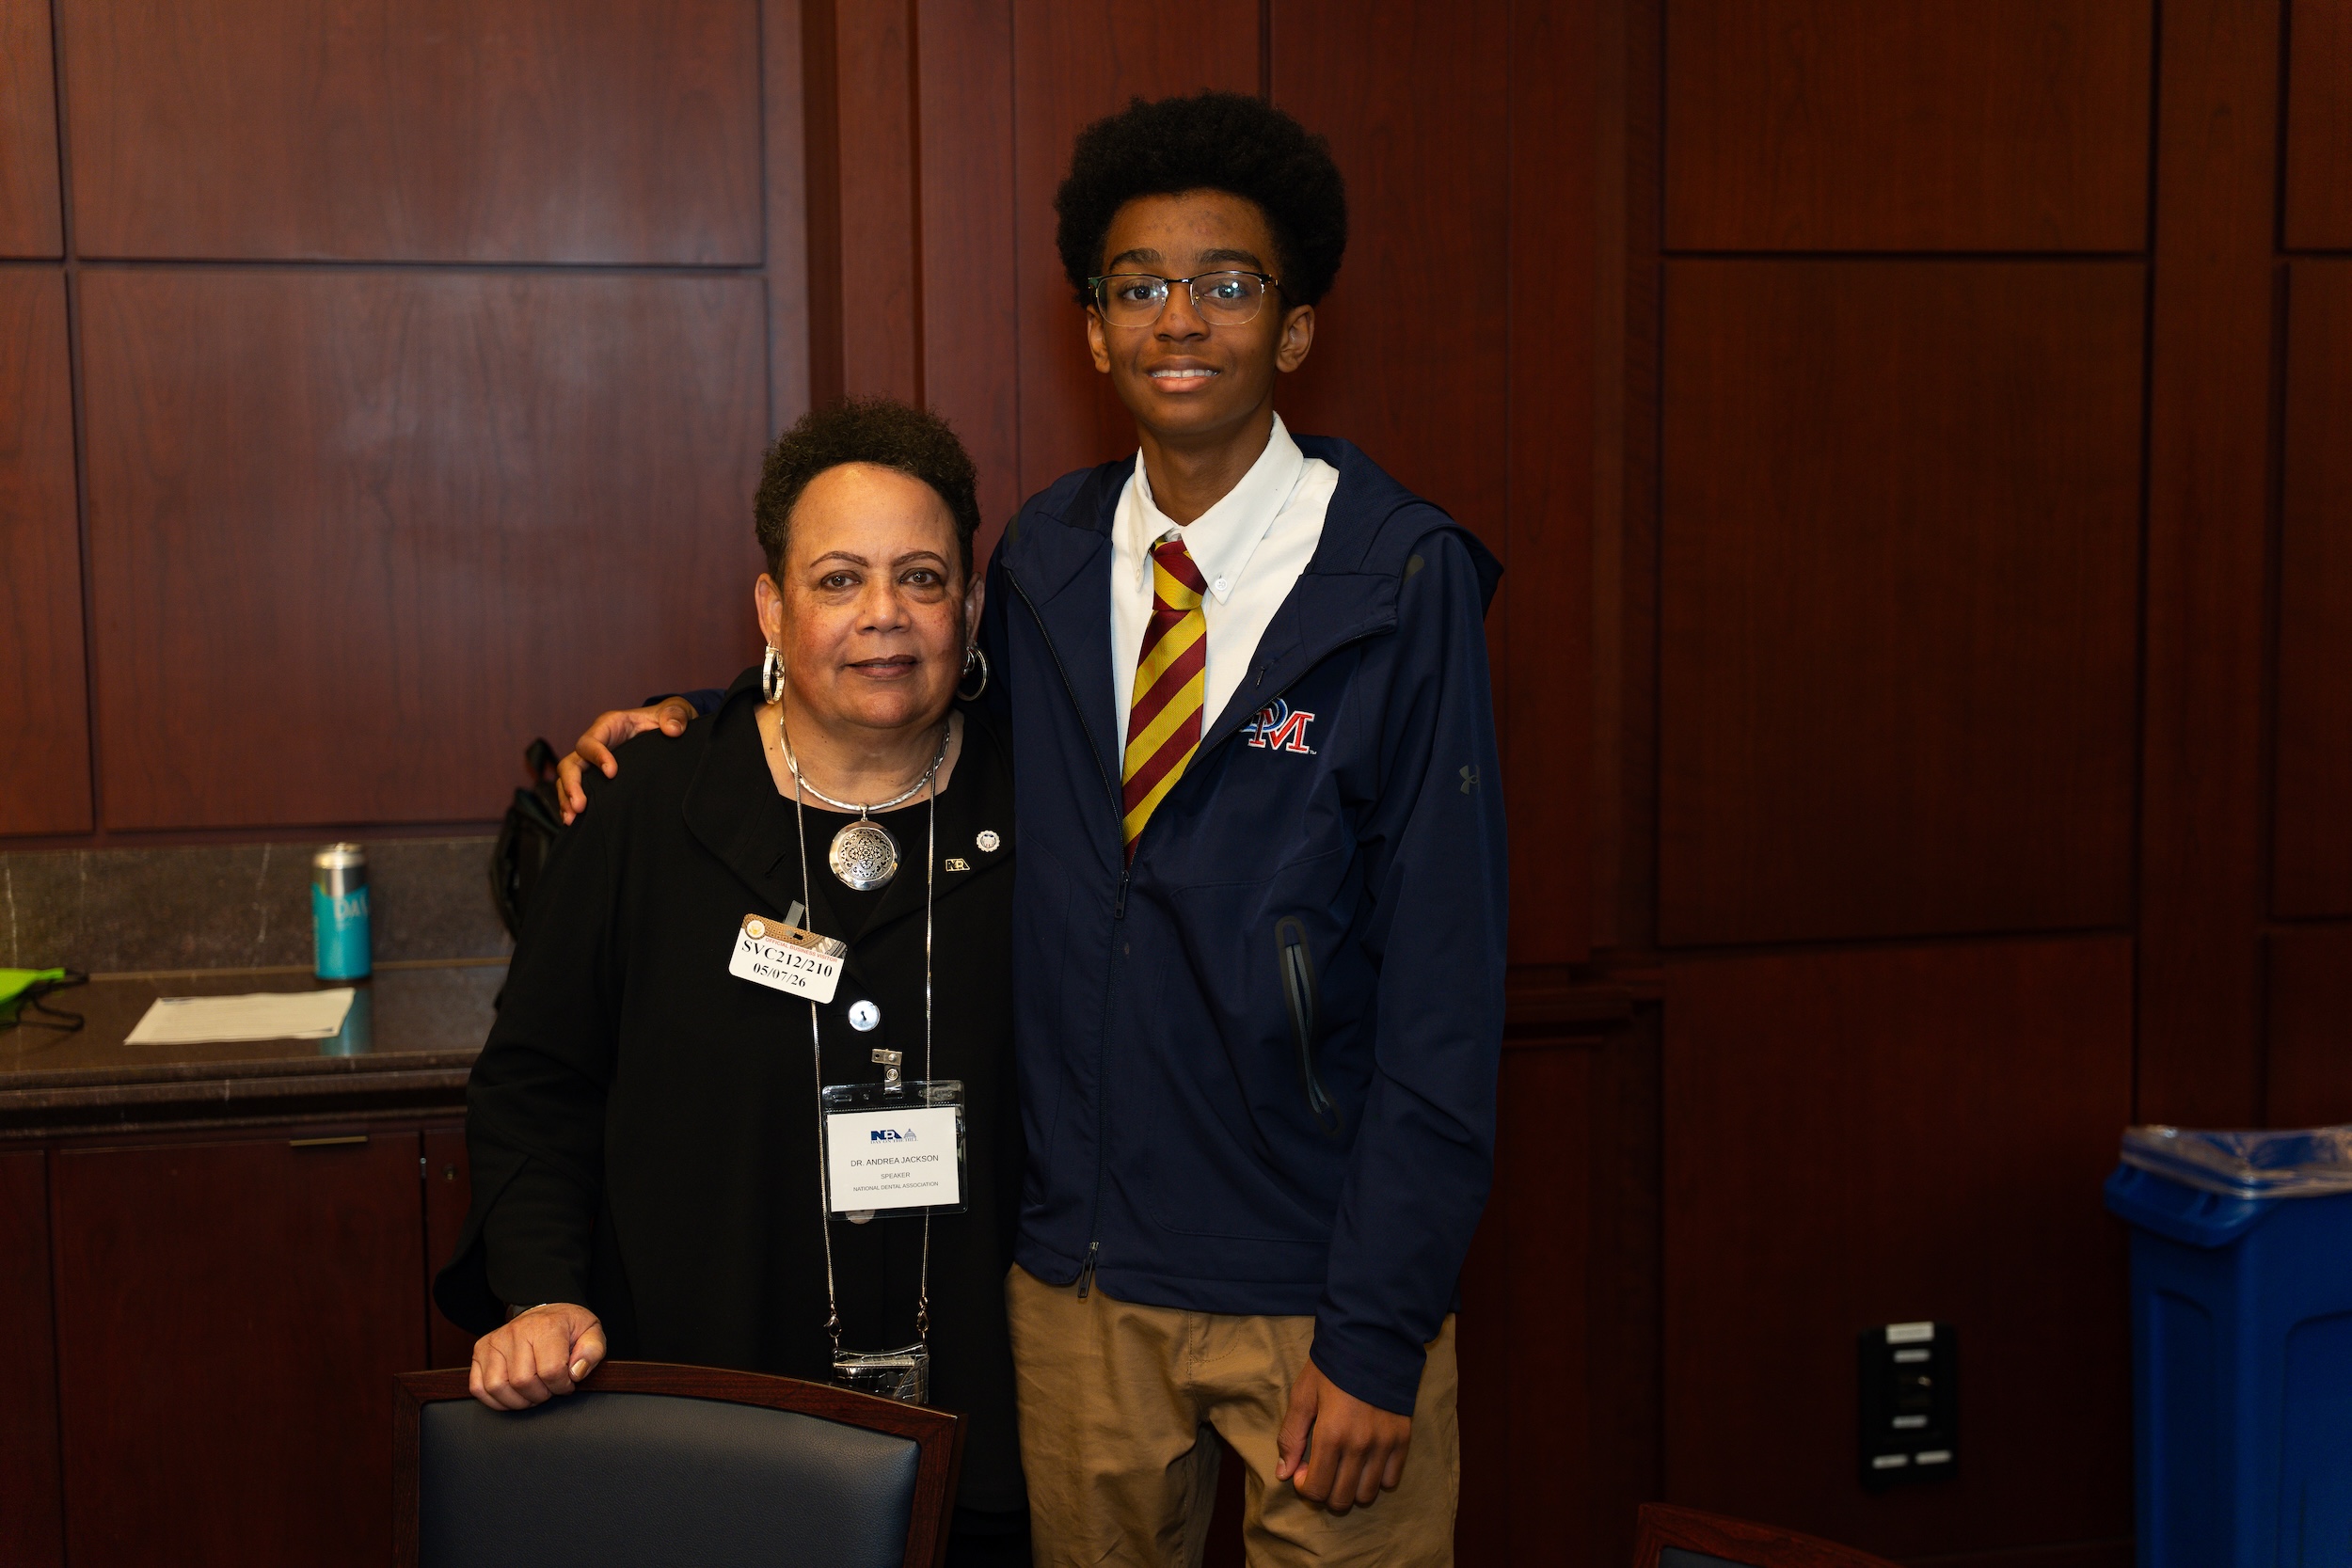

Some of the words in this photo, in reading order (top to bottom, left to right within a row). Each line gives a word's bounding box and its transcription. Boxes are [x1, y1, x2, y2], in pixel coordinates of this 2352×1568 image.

[741, 939, 834, 977] SVC212/210
[765, 937, 789, 949] OFFICIAL
[789, 944, 817, 958] BUSINESS
[817, 953, 838, 963] VISITOR
[753, 962, 806, 989] 05/07/26
[850, 1159, 865, 1167] DR.
[866, 1157, 900, 1166] ANDREA
[900, 1154, 939, 1164] JACKSON
[881, 1171, 911, 1180] SPEAKER
[902, 1180, 939, 1189] ASSOCIATION
